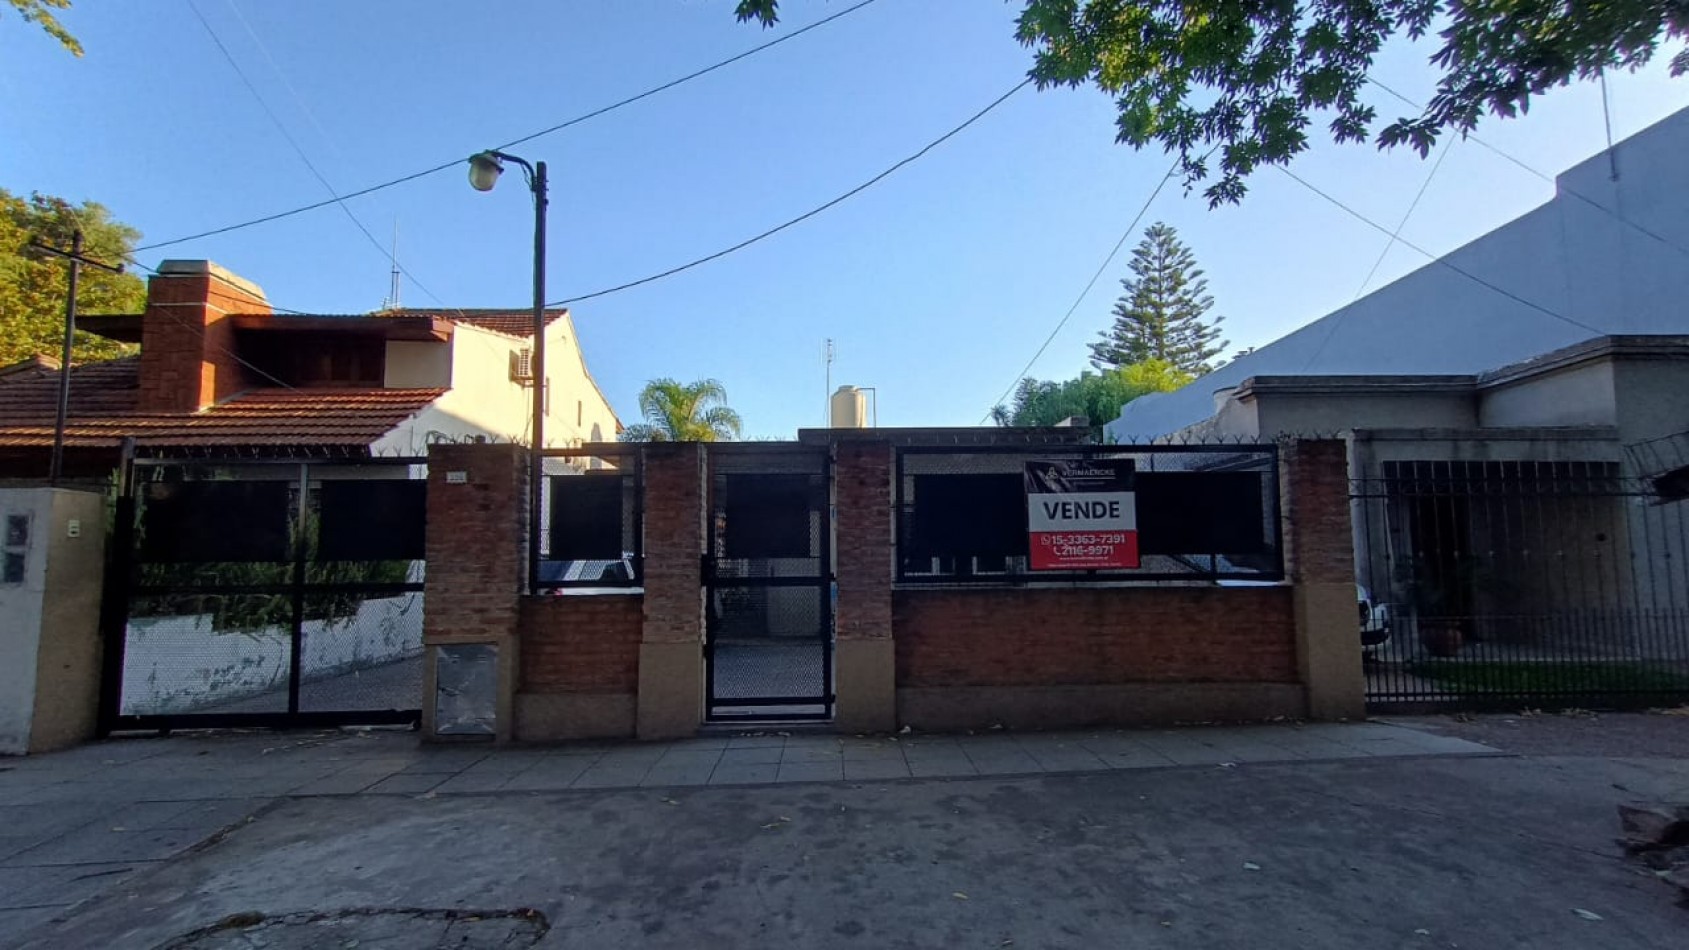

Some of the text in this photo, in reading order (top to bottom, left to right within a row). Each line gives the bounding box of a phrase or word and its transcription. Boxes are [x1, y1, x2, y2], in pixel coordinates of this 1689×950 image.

[1043, 501, 1120, 520] VENDE
[1052, 534, 1125, 545] 15-3363-7391
[1061, 545, 1114, 556] 2116-9971
